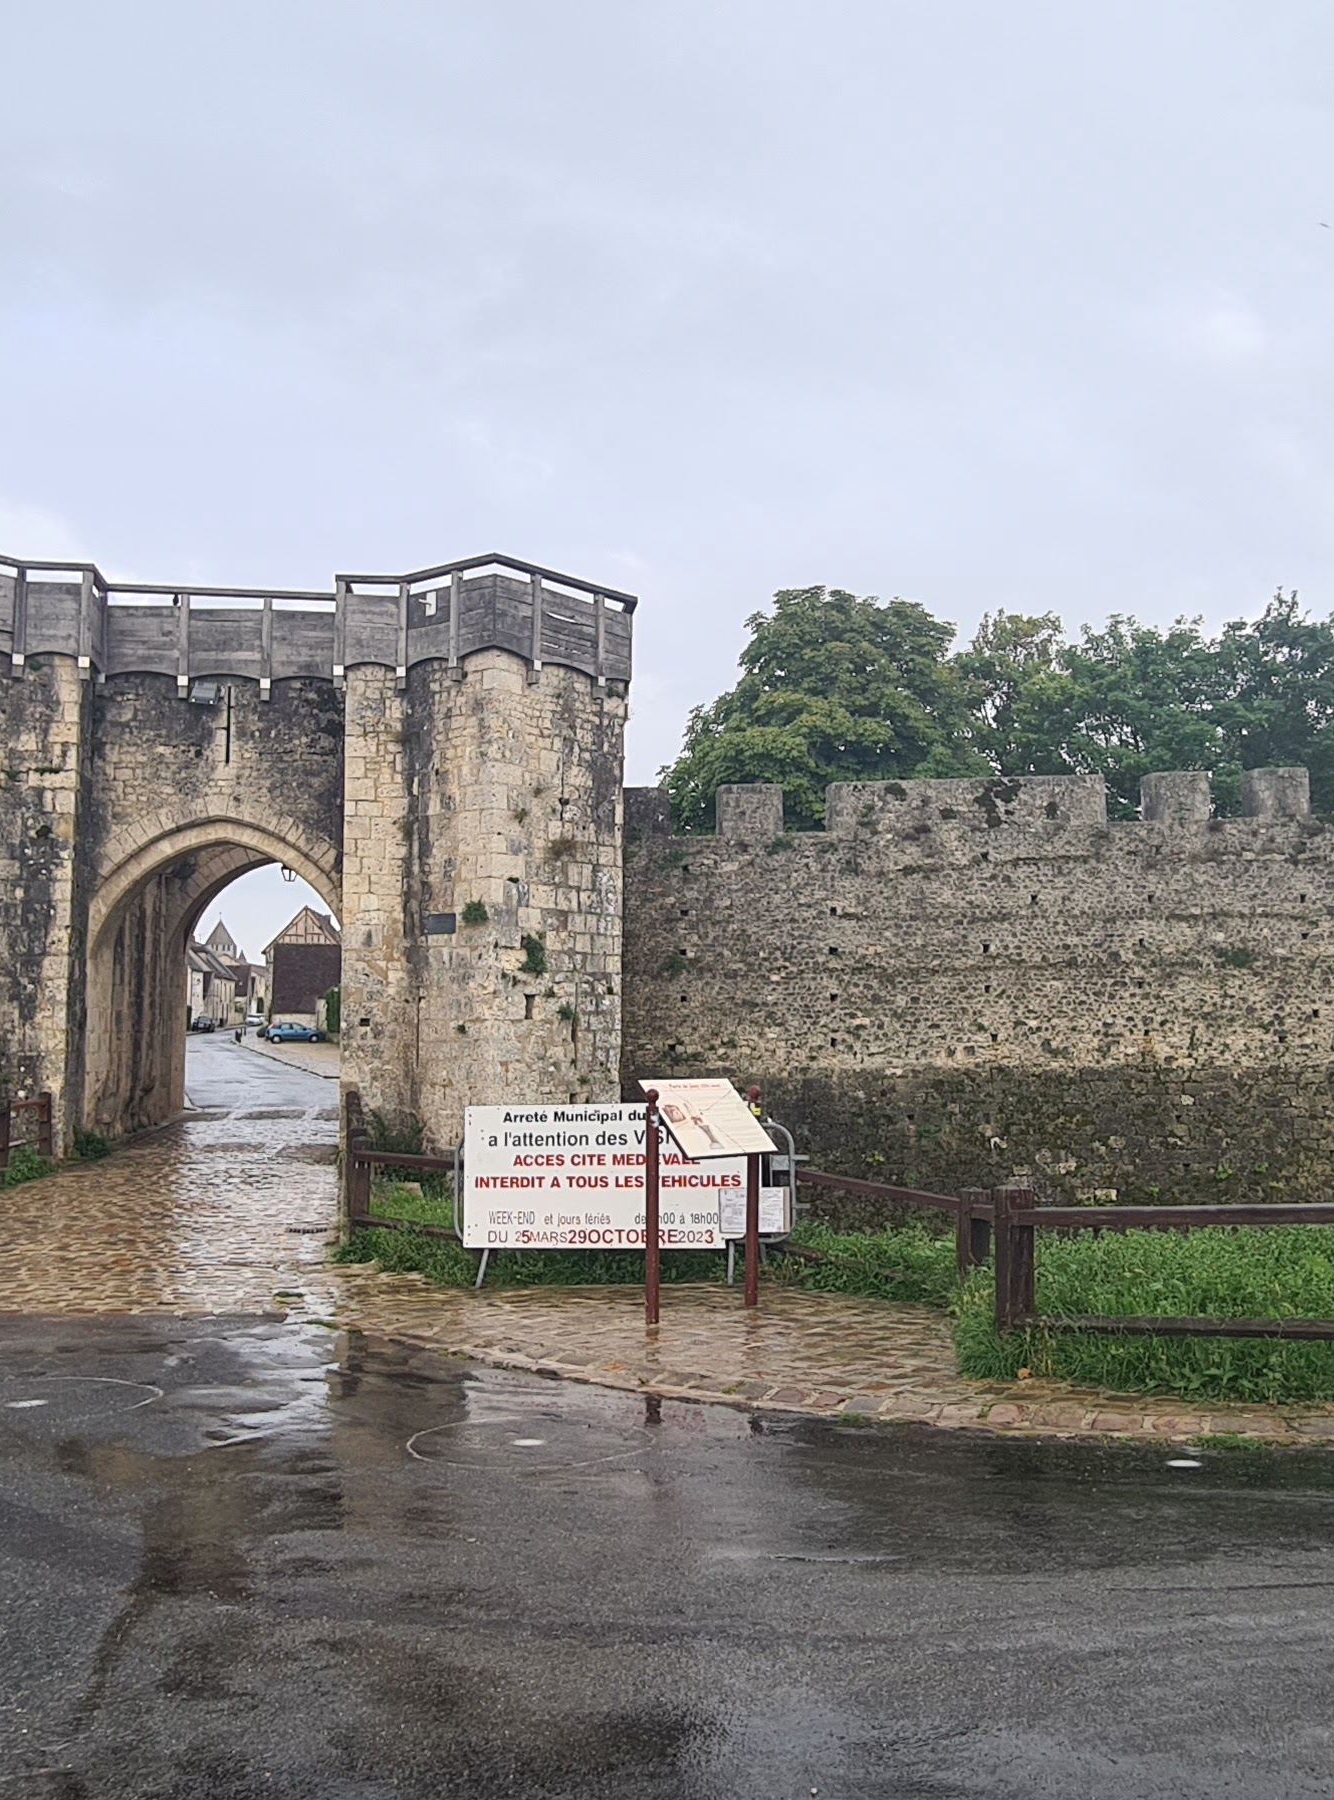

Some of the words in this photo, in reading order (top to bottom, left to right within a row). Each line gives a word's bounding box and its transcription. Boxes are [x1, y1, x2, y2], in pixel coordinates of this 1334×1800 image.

[553, 1109, 622, 1124] Municipal
[628, 1110, 647, 1121] du
[504, 1131, 589, 1147] l'attention
[595, 1131, 628, 1146] des
[513, 1154, 566, 1167] ACCES
[570, 1154, 606, 1166] CITE
[612, 1153, 701, 1166] MEDVAL
[475, 1176, 545, 1189] INTERDIT
[550, 1176, 561, 1188] A
[566, 1175, 609, 1188] TOUS
[615, 1175, 645, 1188] LES
[658, 1174, 742, 1188] EHICULES
[488, 1210, 536, 1225] WEEK-END
[544, 1213, 553, 1225] et
[557, 1212, 581, 1227] jours
[690, 1212, 719, 1225] 18h00
[487, 1230, 508, 1243] DU
